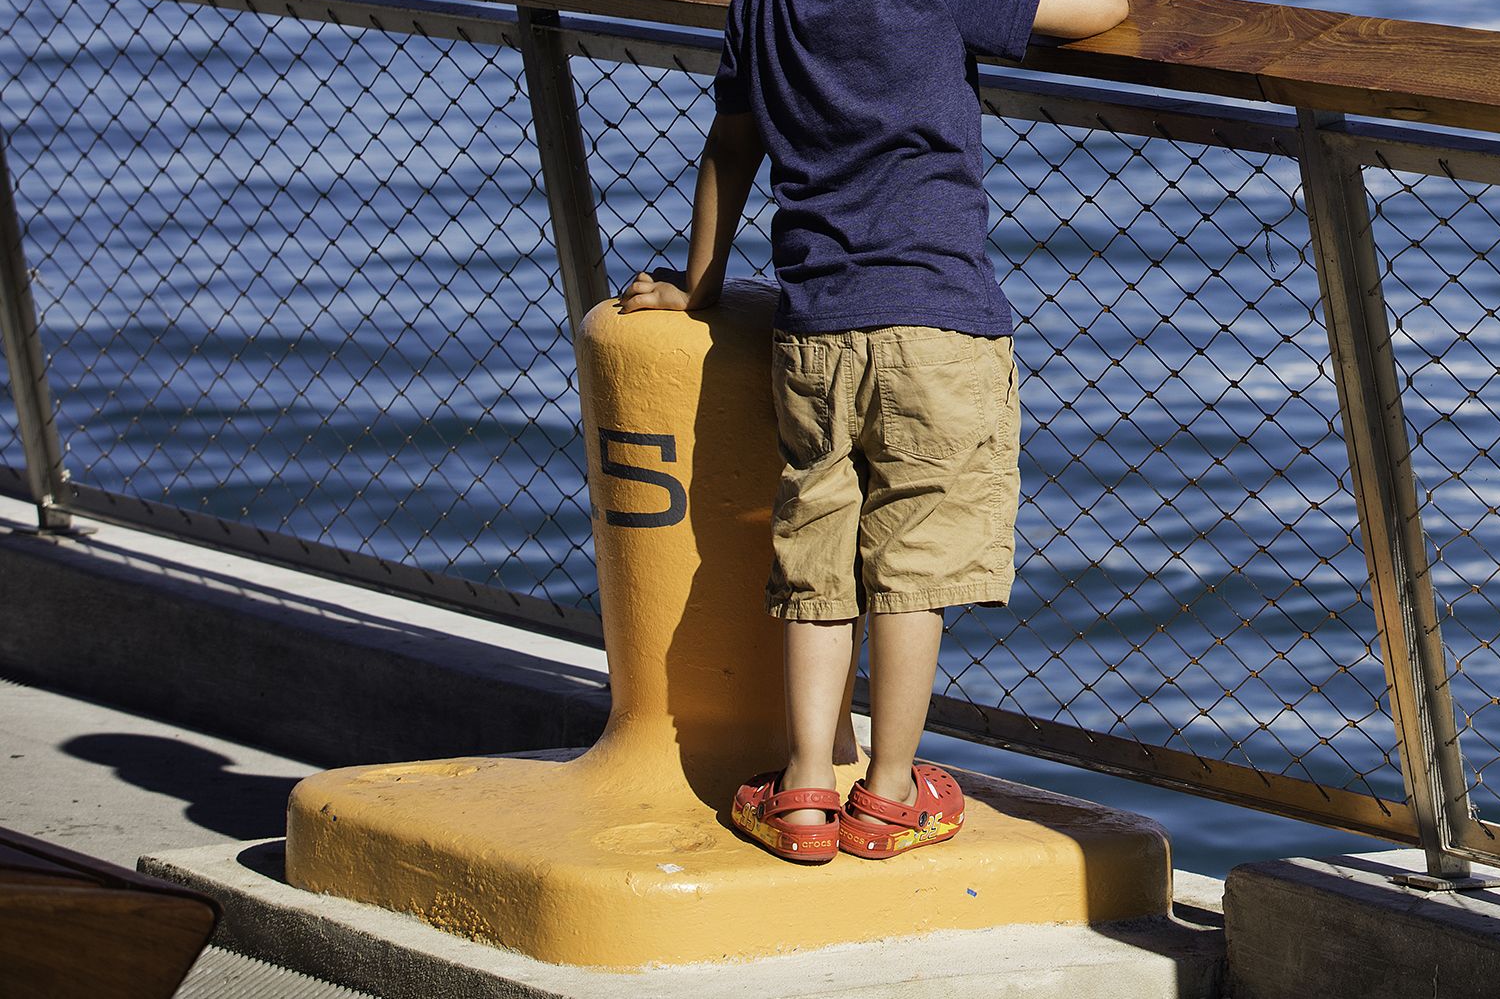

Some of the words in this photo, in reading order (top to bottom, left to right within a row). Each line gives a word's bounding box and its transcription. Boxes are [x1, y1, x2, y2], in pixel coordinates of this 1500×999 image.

[598, 427, 687, 528] 5
[919, 811, 943, 841] 95
[801, 839, 832, 849] crocs
